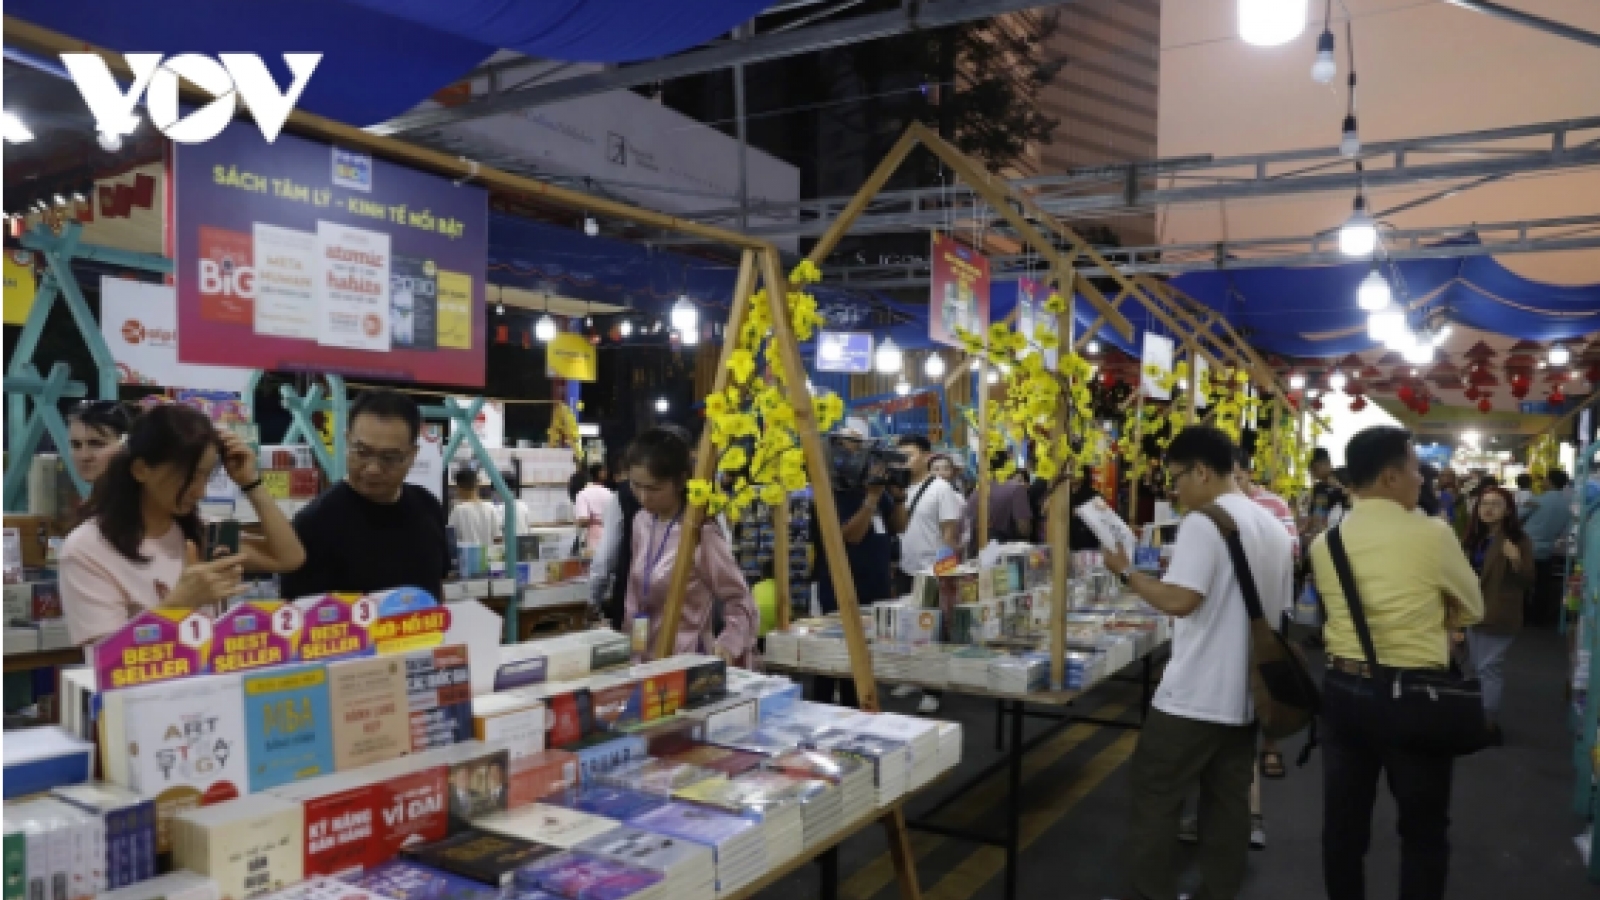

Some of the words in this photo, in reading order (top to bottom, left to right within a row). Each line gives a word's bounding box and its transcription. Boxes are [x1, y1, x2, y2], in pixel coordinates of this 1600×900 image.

[213, 164, 267, 193] SÁCH
[271, 178, 310, 203] TÂM
[311, 186, 332, 207] LÝ
[348, 197, 386, 219] KINH
[325, 244, 384, 268] atomic
[325, 270, 381, 296] habits
[281, 609, 293, 630] 2
[360, 601, 370, 621] 3
[189, 619, 199, 641] 1
[310, 623, 348, 642] BEST
[223, 632, 267, 653] BEST
[302, 636, 360, 659] SELLER
[123, 643, 174, 666] BEST
[214, 646, 282, 673] SELLER
[111, 658, 190, 686] SELLER
